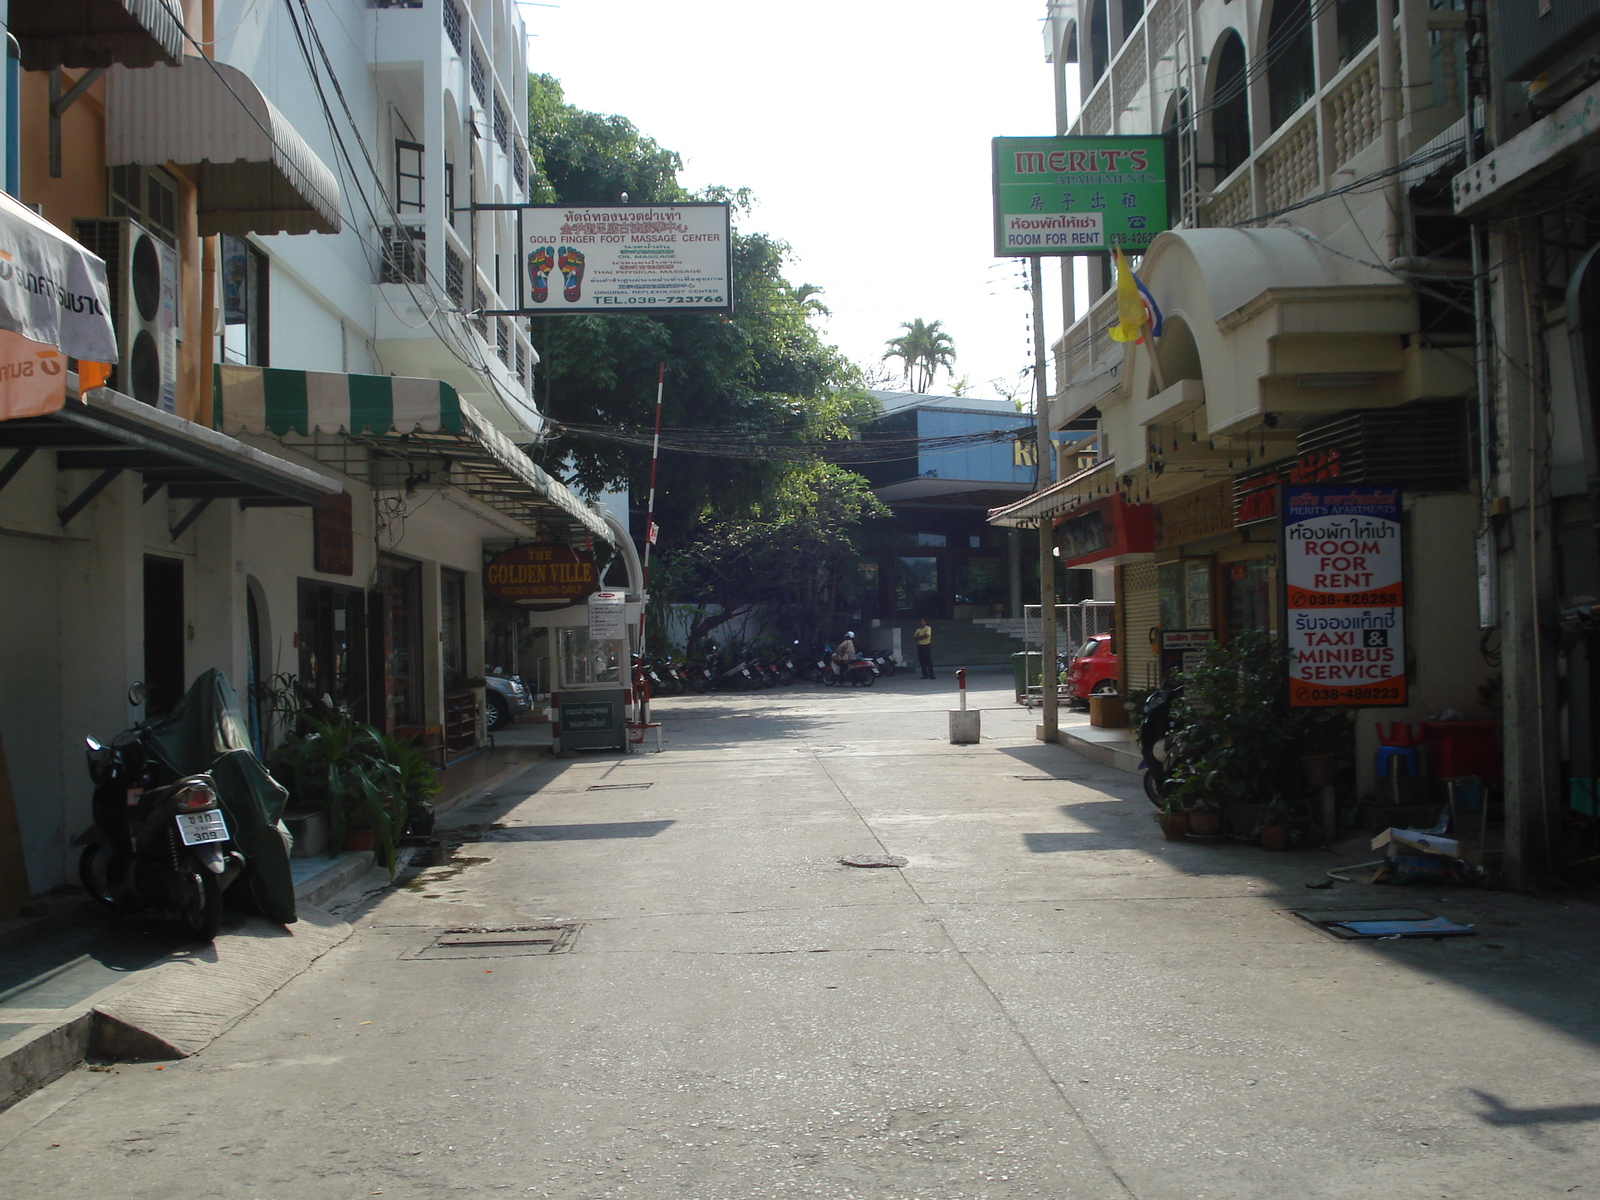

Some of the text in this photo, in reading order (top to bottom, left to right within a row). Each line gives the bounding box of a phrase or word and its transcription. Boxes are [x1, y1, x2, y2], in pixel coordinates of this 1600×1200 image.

[1014, 150, 1148, 173] MERIT'S
[1055, 173, 1157, 185] APARTMENTS
[563, 208, 682, 222] หัตถ์ทองนวดฝ่าเท้า
[1010, 214, 1096, 229] ห้องพักให้เช่า
[529, 233, 720, 244] GOLD FINGER FOOT MASSAGE CENTER
[1008, 232, 1100, 245] ROOM FOR RENT
[1331, 504, 1396, 514] APARTMENTS
[1304, 540, 1380, 555] ROOM
[528, 551, 552, 560] THE
[1320, 556, 1367, 572] FOR
[488, 563, 592, 584] GOLDEN VILLE
[1314, 572, 1374, 588] RENT
[1308, 593, 1397, 606] 038-426258
[1304, 631, 1384, 646] TAXI &
[1297, 648, 1395, 664] MINIBUS
[1300, 664, 1393, 681] SERVICE
[194, 832, 217, 841] 309
